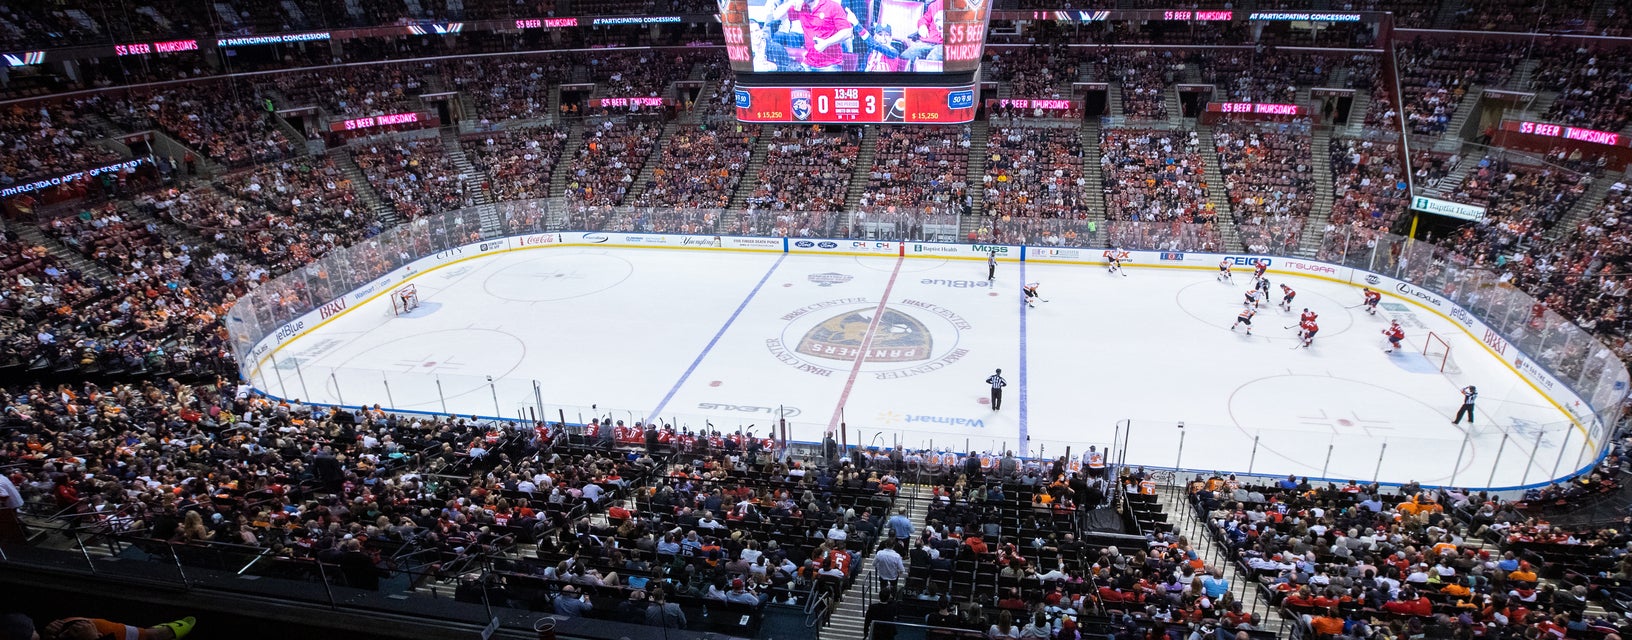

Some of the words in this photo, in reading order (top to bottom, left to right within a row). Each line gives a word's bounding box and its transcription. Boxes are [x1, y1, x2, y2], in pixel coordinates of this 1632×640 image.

[1164, 11, 1173, 20] $5
[1174, 11, 1191, 20] BEER
[1195, 11, 1232, 20] THURSDAYS
[1310, 14, 1360, 22] CONCESSIONS
[516, 20, 526, 29] $5
[526, 19, 541, 28] BEER
[545, 18, 577, 27] THURSDAYS
[228, 36, 282, 45] PARTICIPATING
[282, 32, 330, 41] CONCESSIONS
[950, 24, 964, 43] $5
[116, 45, 129, 56] $5
[129, 44, 151, 55] BEER
[154, 40, 198, 53] THURSDAYS
[834, 89, 858, 99] 13:48
[601, 98, 611, 107] $5
[611, 98, 627, 107] BEER
[818, 95, 828, 114] 0
[865, 95, 876, 114] 3
[1032, 100, 1070, 109] THURSDAYS
[1222, 103, 1232, 112] $5
[1233, 103, 1252, 113] BEER
[1255, 104, 1297, 115] THURSDAYS
[345, 120, 356, 130] $5
[356, 118, 374, 129] BEER
[377, 113, 417, 125] THURSDAYS
[1521, 122, 1534, 133] $5
[1535, 124, 1560, 136] BEER
[1565, 127, 1617, 146] THURSDAYS
[89, 168, 101, 177] OF
[1456, 206, 1483, 218] Health
[436, 246, 464, 260] CITY
[1285, 261, 1336, 274] IT'SUGAR
[355, 286, 375, 300] Walmart
[1410, 290, 1441, 306] LEXUS
[319, 296, 347, 320] BB&T
[1449, 306, 1474, 327] jetBlue
[275, 321, 304, 344] jetBlue
[1483, 328, 1509, 356] BB&T
[812, 343, 916, 358] PANTHERS
[874, 358, 944, 380] CENTER
[698, 402, 772, 414] LEXUS
[904, 413, 985, 428] Walmart
[835, 557, 844, 570] 5
